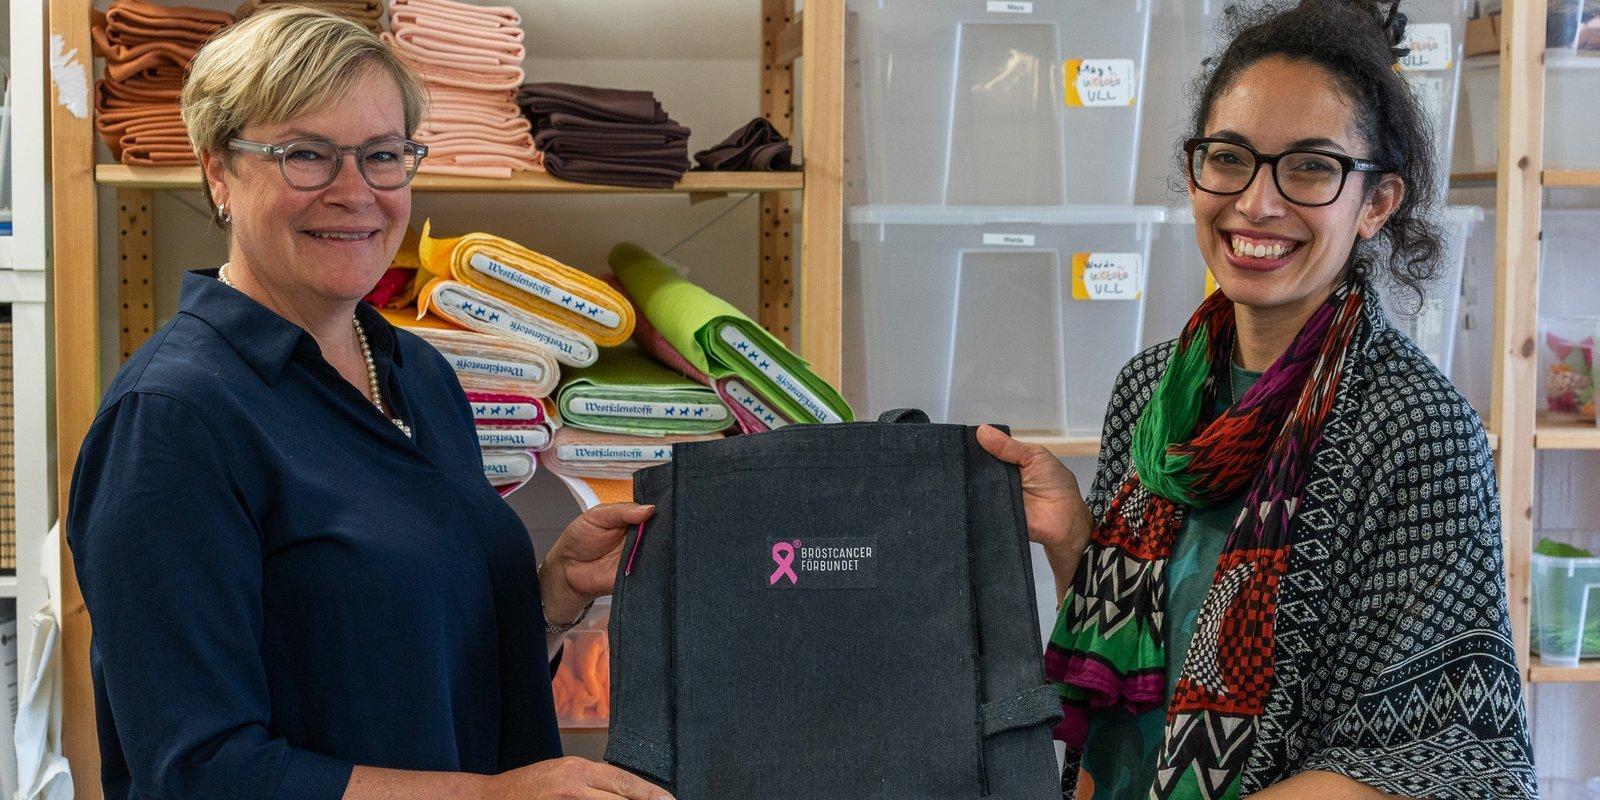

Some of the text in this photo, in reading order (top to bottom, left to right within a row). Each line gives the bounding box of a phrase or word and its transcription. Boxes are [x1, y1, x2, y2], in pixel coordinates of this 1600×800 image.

[1087, 90, 1117, 102] ULL
[488, 261, 552, 295] Westfalenstoffe
[1094, 283, 1124, 295] ULL
[509, 320, 573, 355] Westfalenstoffe
[456, 359, 524, 377] Westfalenstoffe
[775, 373, 828, 423] Westfalenstoffe
[584, 402, 653, 414] Westfalenstoffe
[574, 448, 643, 460] Westfalenstoffe
[801, 546, 873, 559] BRÖSTCANCER
[801, 559, 859, 571] FÖRBUNDET
